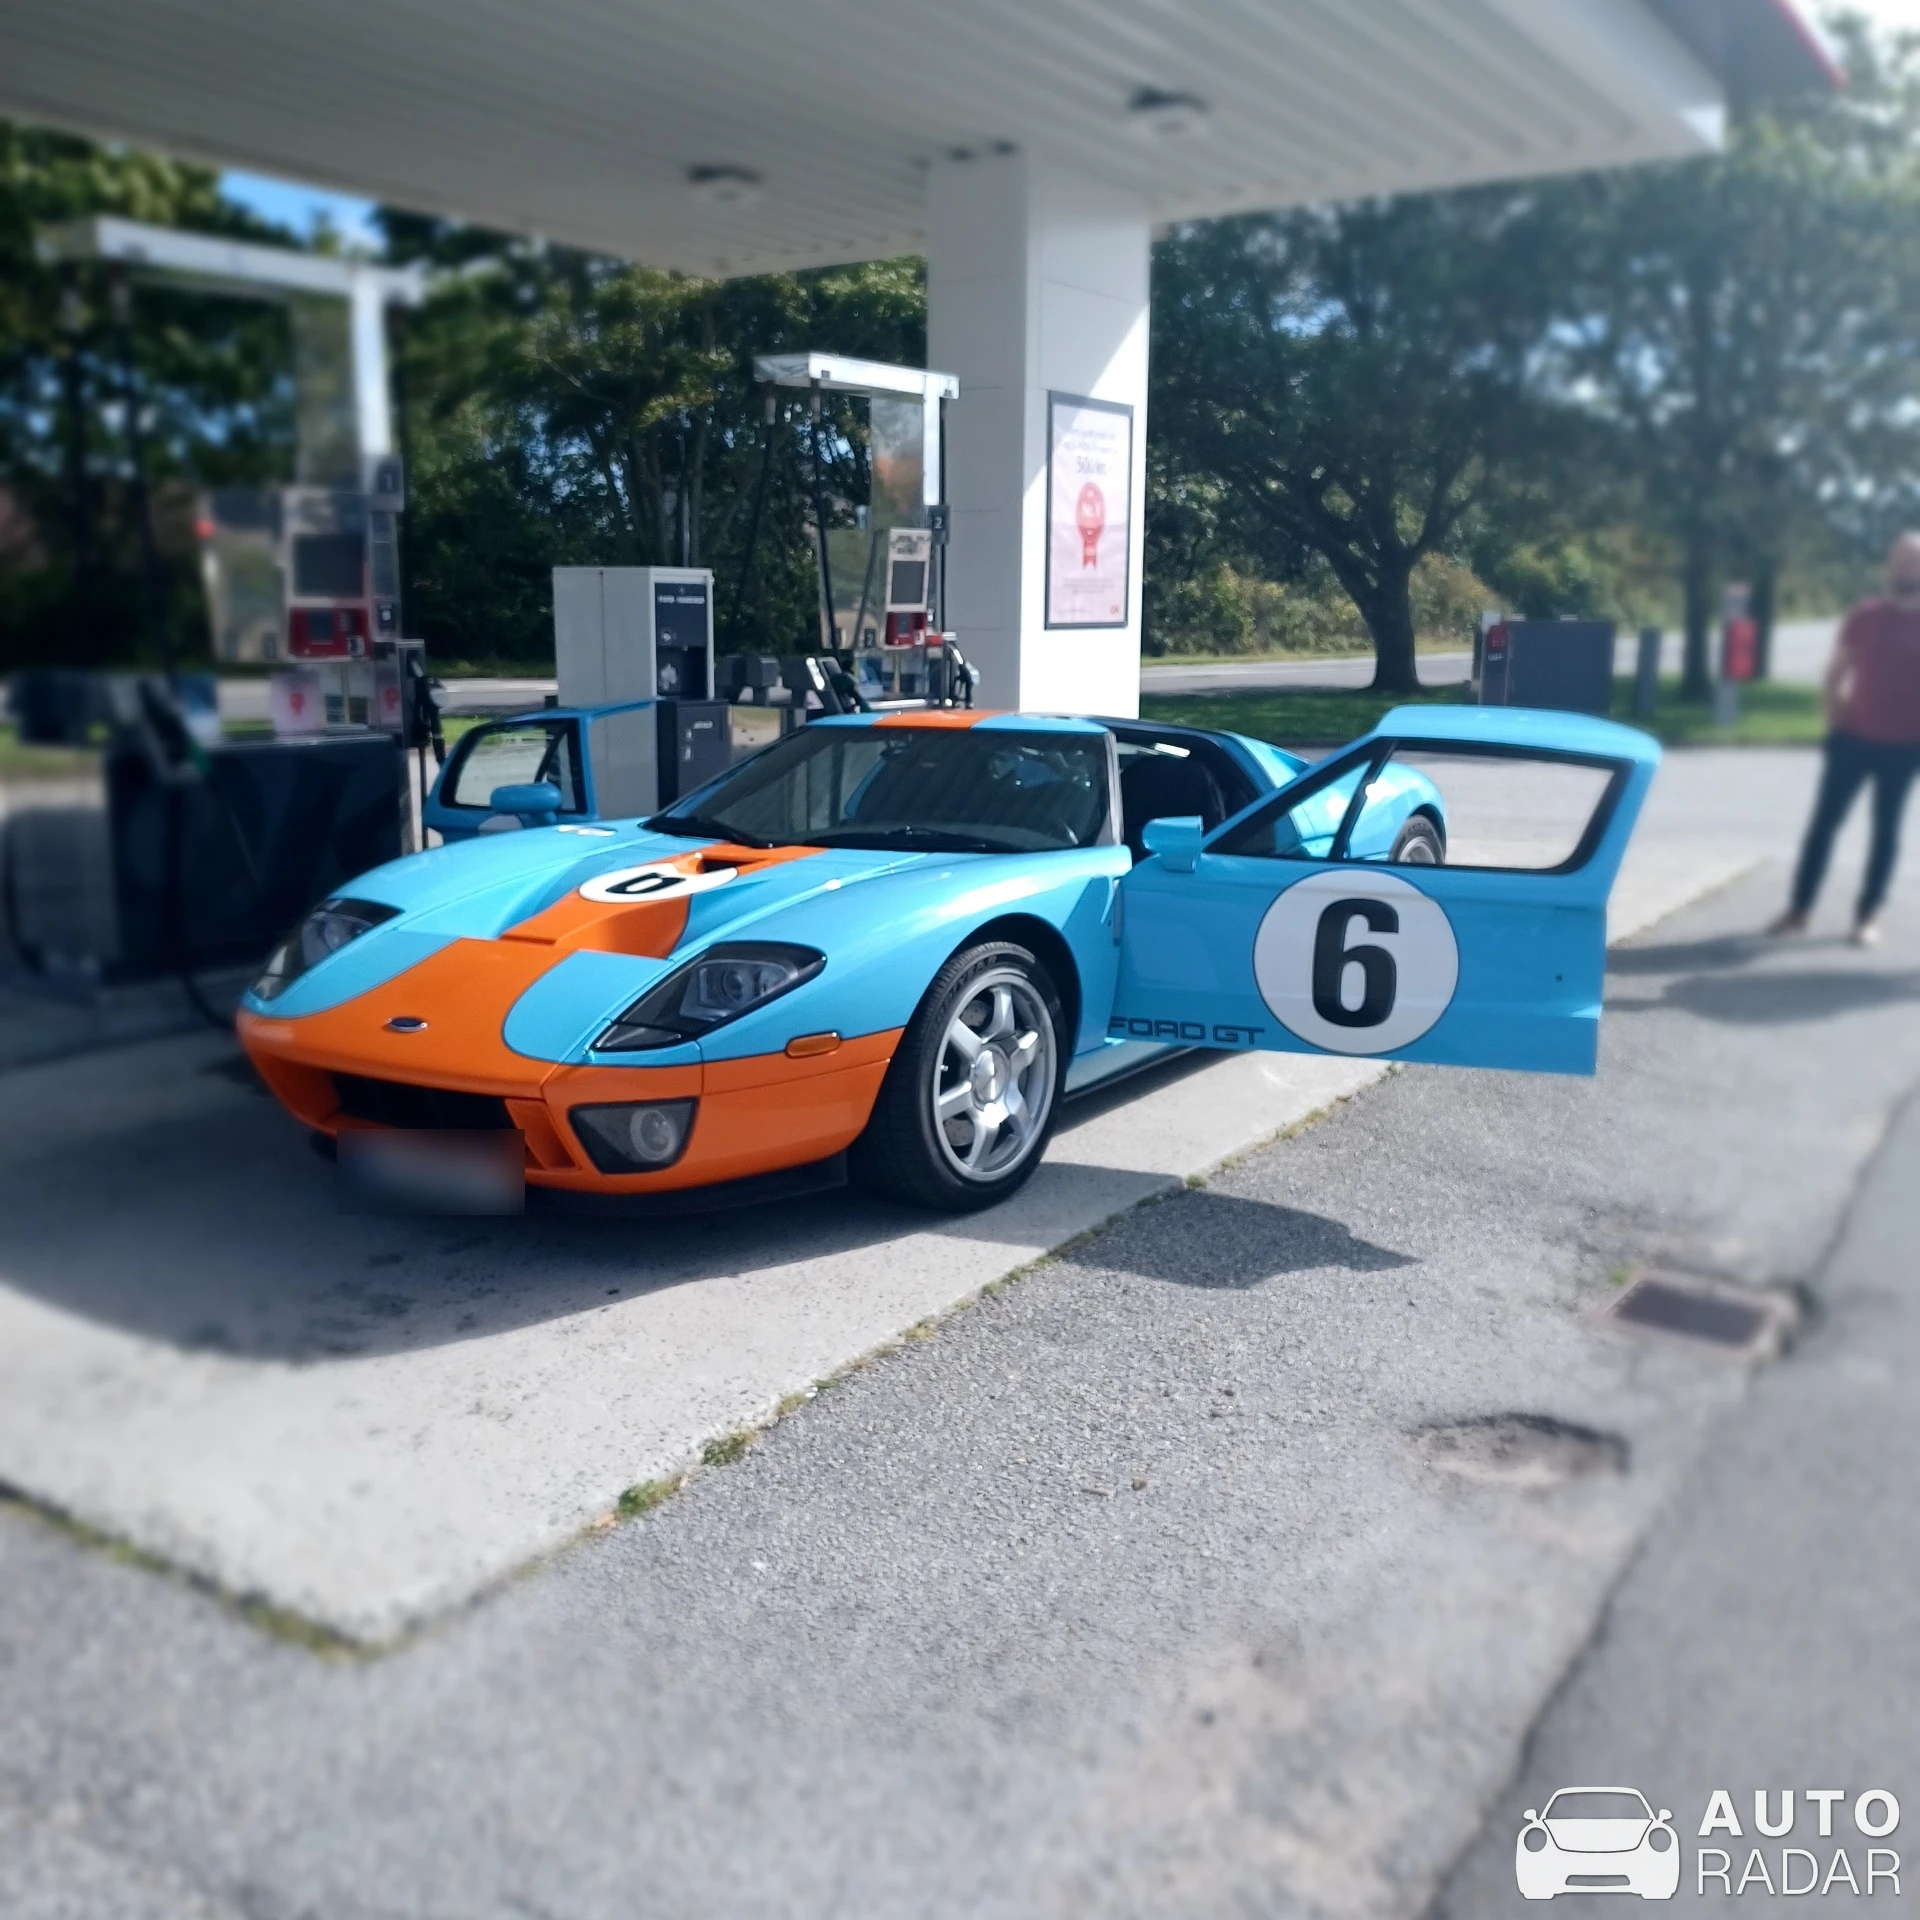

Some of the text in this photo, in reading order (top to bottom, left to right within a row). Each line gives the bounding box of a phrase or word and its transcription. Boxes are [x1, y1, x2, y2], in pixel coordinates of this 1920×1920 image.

[934, 517, 943, 529] 2
[1312, 898, 1400, 1028] 6
[1107, 1015, 1266, 1045] FORD GT
